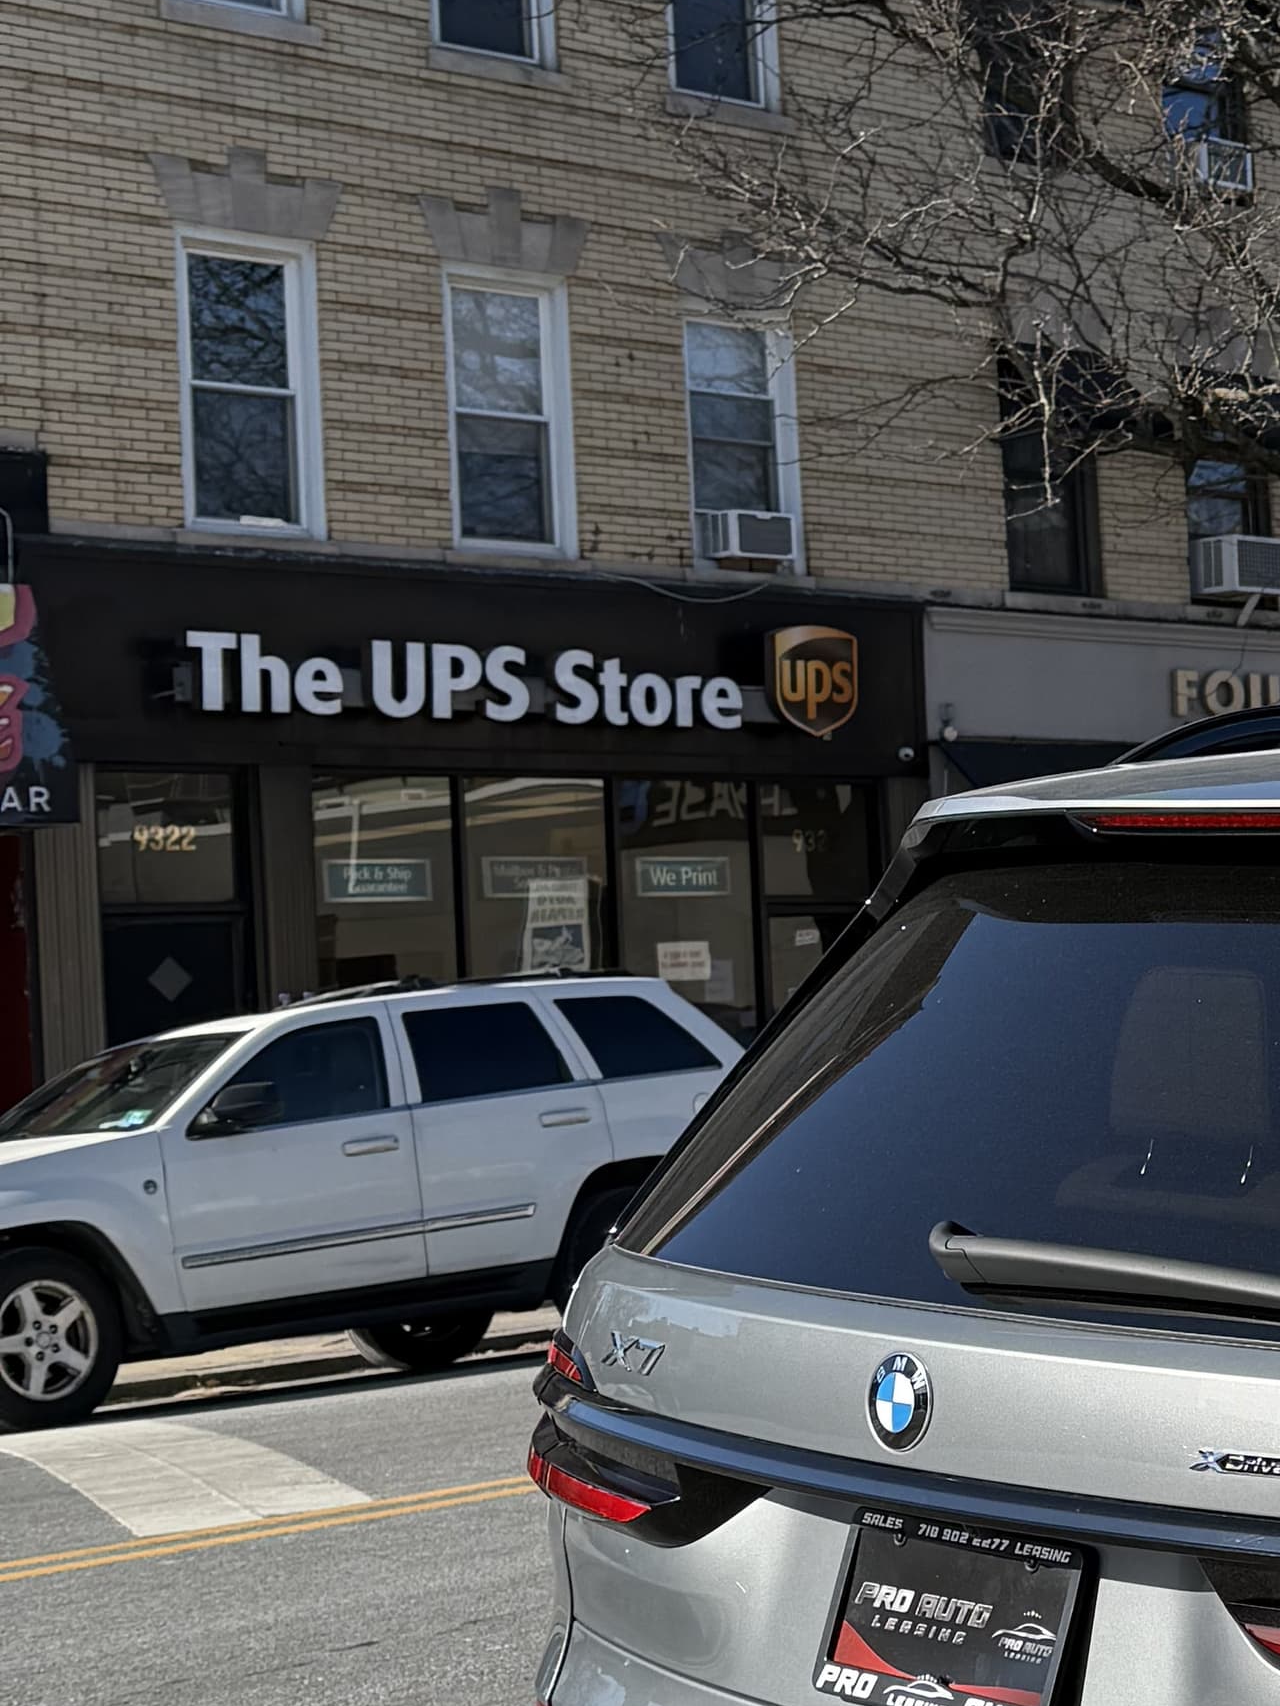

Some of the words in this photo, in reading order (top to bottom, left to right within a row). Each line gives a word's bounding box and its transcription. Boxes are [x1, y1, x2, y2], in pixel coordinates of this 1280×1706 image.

[186, 630, 343, 715] The
[369, 639, 531, 723] UPS
[553, 649, 744, 730] Store
[782, 656, 853, 721] ups
[133, 824, 197, 852] 9322
[651, 869, 676, 886] We
[681, 866, 718, 886] Print
[601, 1330, 666, 1377] X7
[876, 1354, 927, 1391] BMW
[861, 1512, 904, 1530] SALES
[942, 1527, 969, 1545] 902
[1014, 1542, 1072, 1564] LEASING
[854, 1581, 915, 1613] PRO
[915, 1594, 993, 1629] AUTO
[871, 1614, 967, 1645] LEASING
[998, 1636, 1022, 1651] PRO
[815, 1664, 878, 1700] PRO
